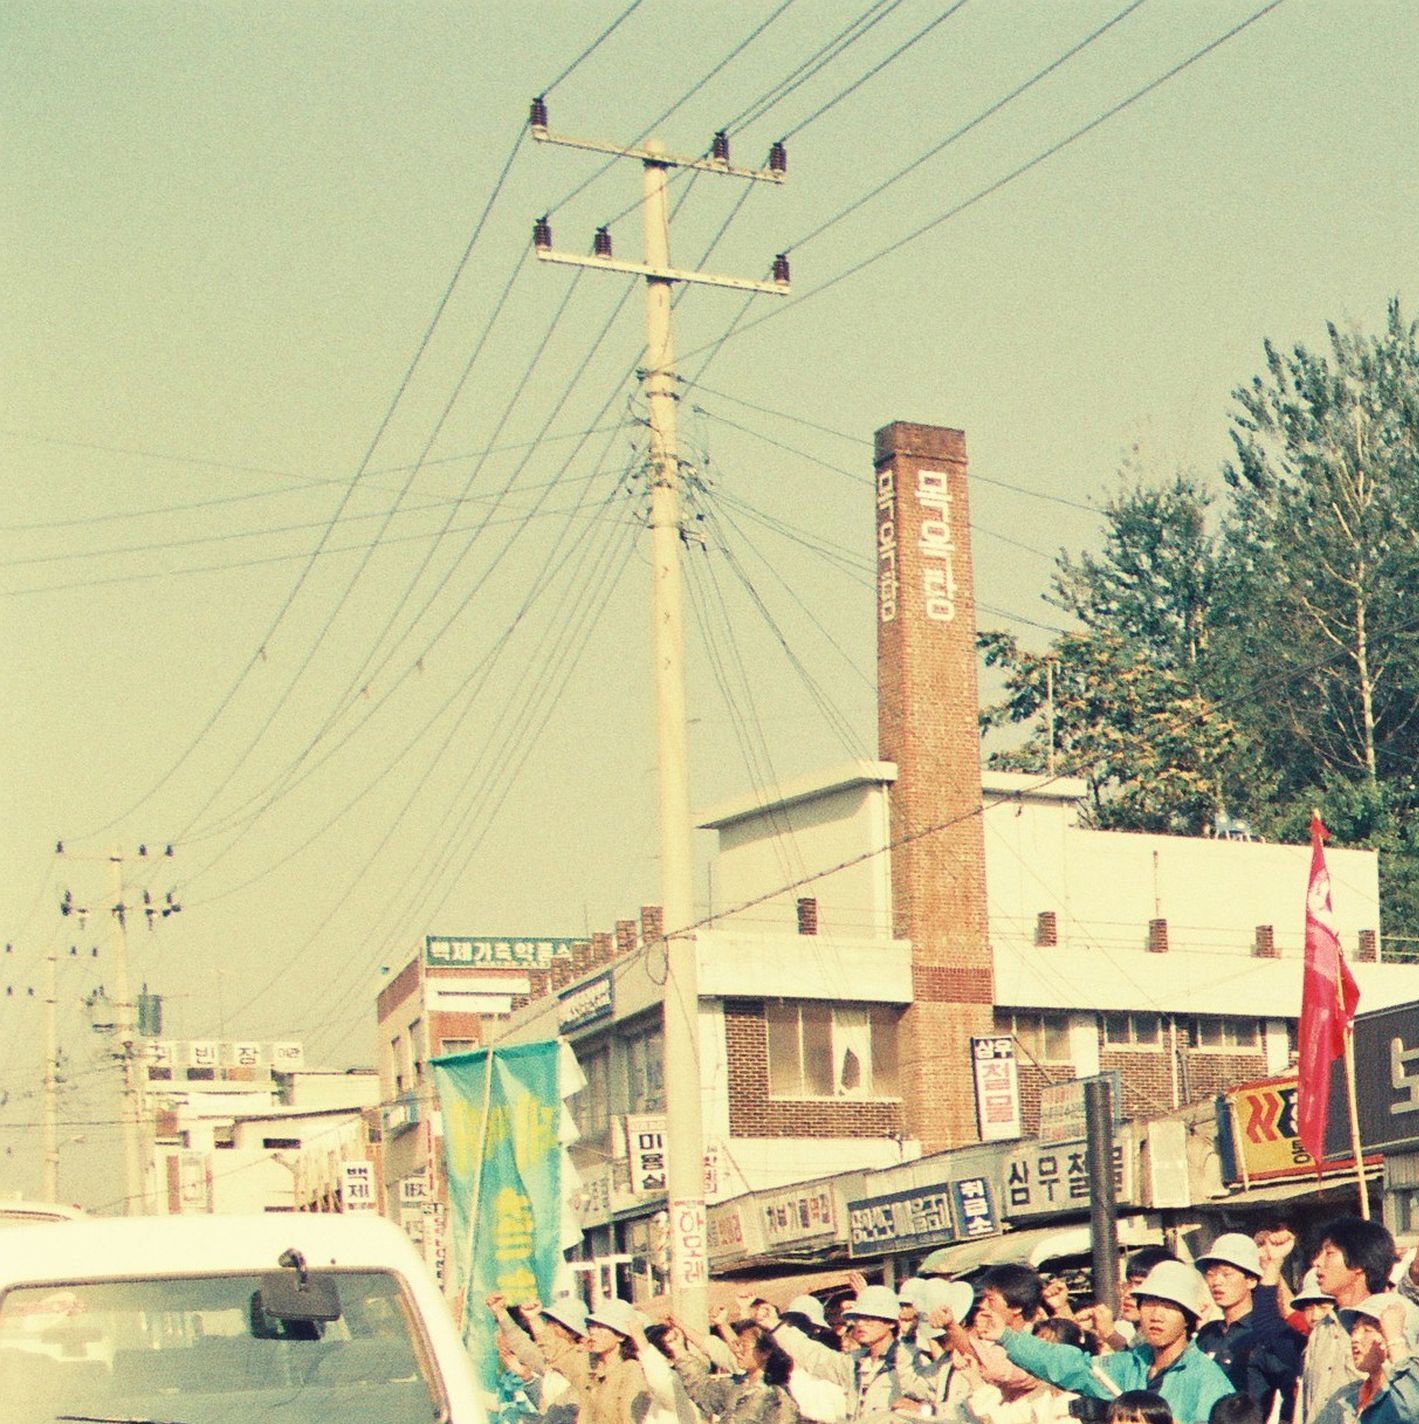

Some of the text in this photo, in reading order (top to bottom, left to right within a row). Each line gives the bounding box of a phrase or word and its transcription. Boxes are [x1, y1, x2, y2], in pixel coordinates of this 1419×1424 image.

[915, 469, 957, 622] 목욕탕
[975, 1040, 1014, 1060] 삼우
[983, 1063, 1014, 1124] 철물
[639, 1133, 667, 1191] 미용실
